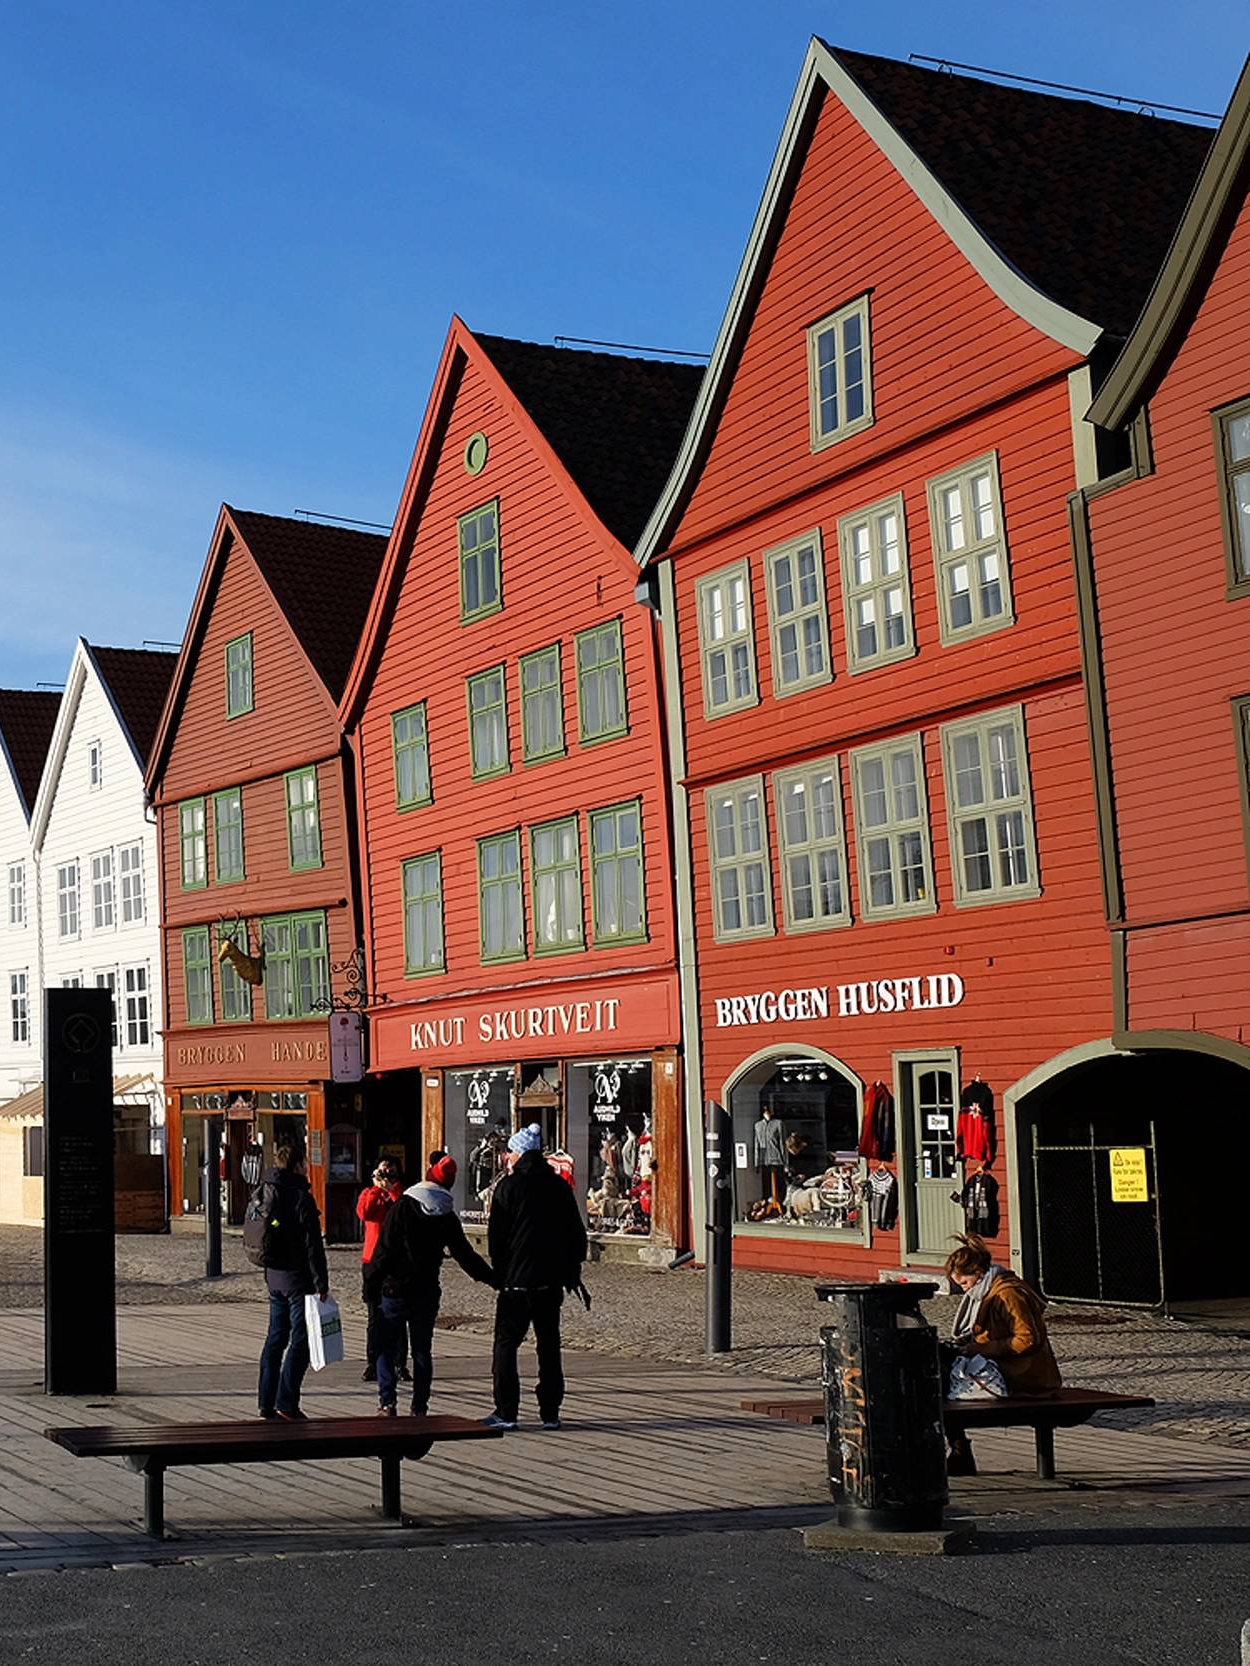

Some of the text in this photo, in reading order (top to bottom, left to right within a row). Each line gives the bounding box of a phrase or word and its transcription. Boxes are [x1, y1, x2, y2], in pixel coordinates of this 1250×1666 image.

[410, 999, 621, 1050] KNUT SKURTVEIT
[714, 972, 965, 1028] BRYGGEN HUSFLID
[177, 1043, 247, 1067] BRYGGEN
